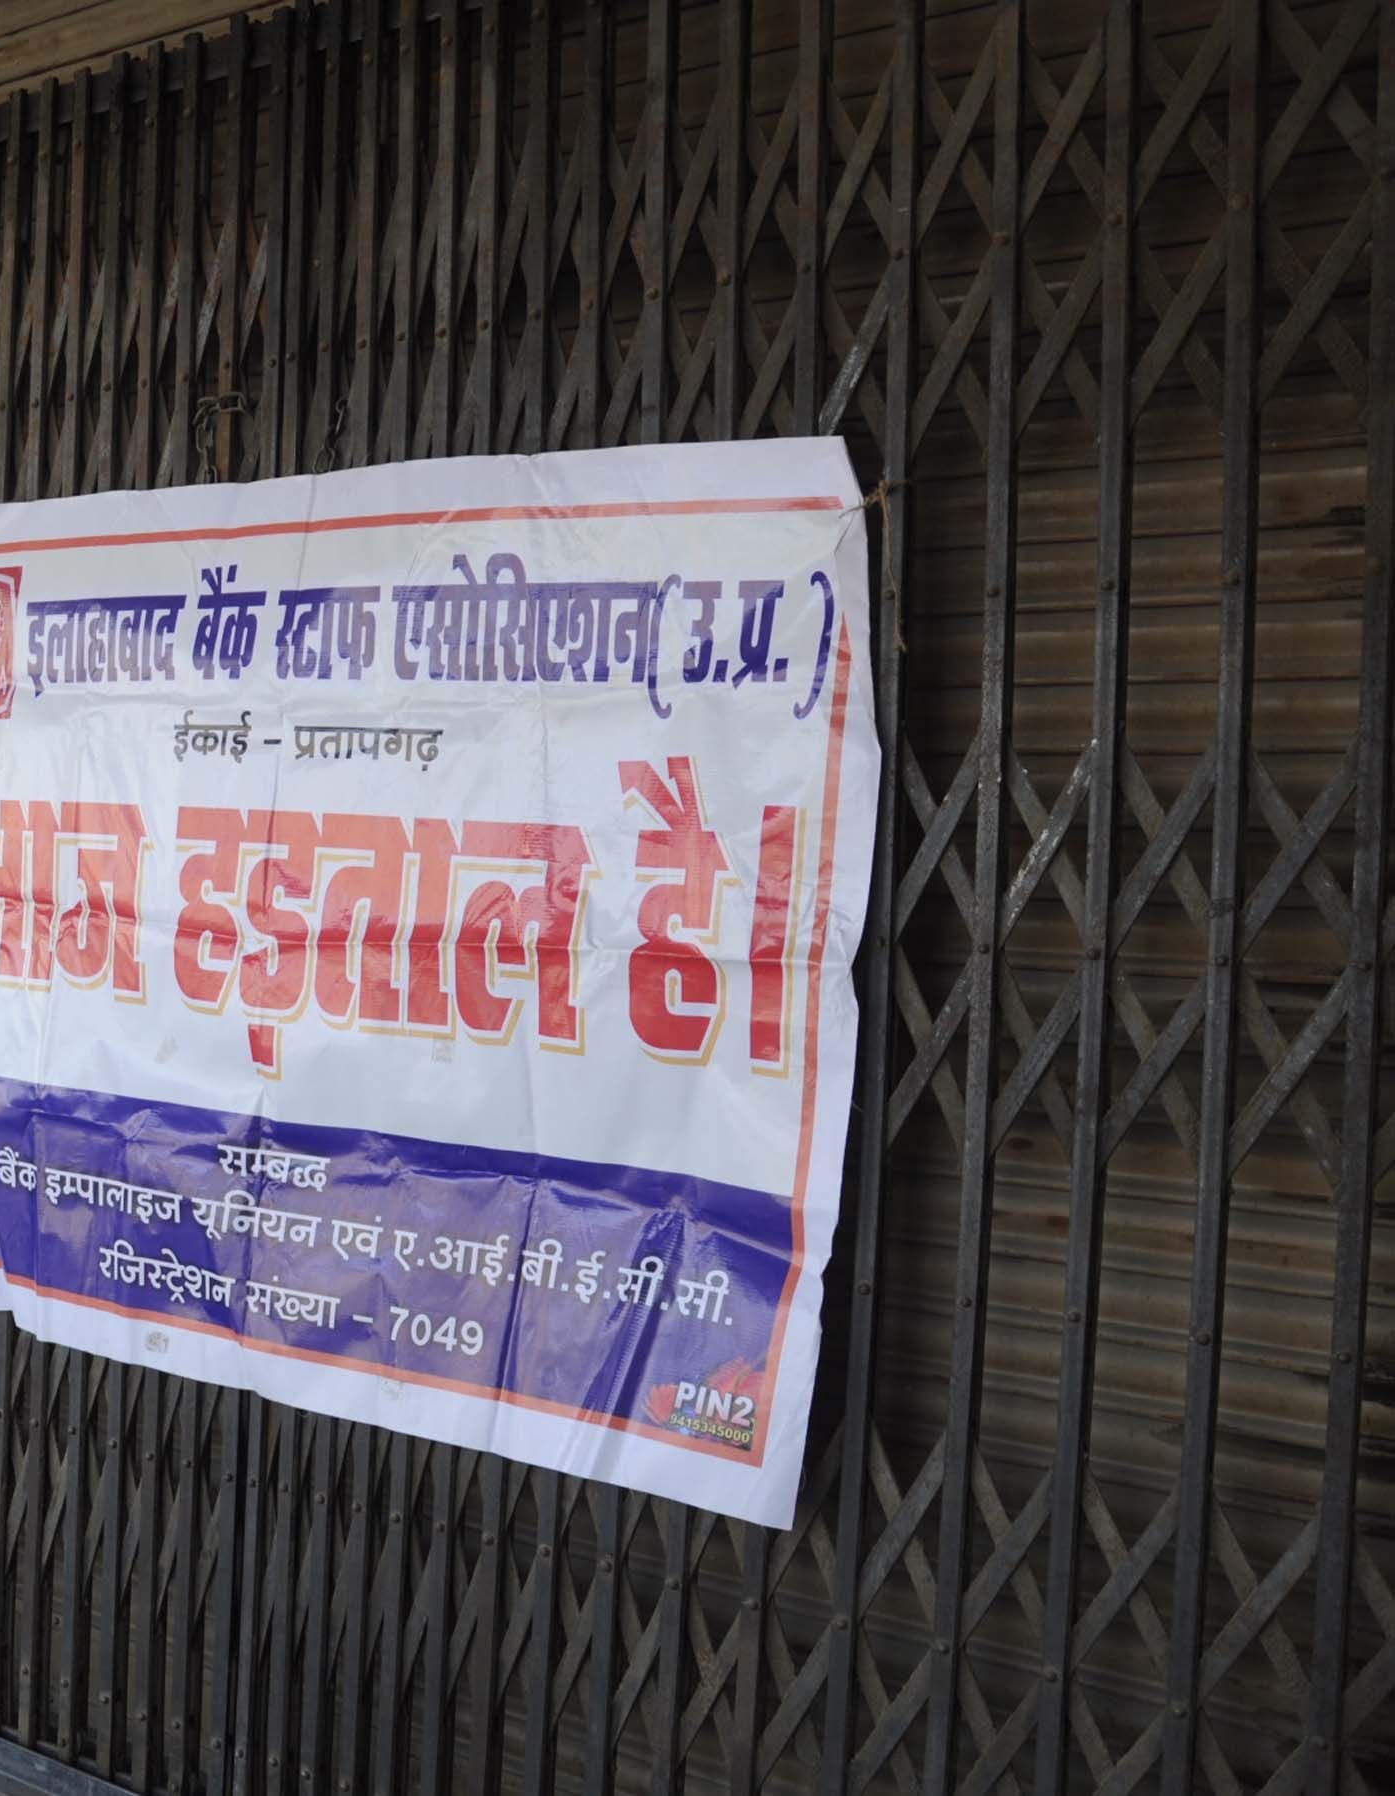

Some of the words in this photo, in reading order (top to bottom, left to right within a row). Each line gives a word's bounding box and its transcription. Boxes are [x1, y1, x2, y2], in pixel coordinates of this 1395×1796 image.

[26, 594, 187, 698] इलाहाबाद
[192, 564, 267, 681] बैंक
[274, 585, 382, 681] स्टाफ
[173, 710, 252, 763] ईकाई
[294, 724, 444, 771] प्रतापगढ़
[172, 805, 603, 1080] हड़ताल
[45, 1166, 183, 1225] इम्पालाइज
[192, 1190, 321, 1248] यूनियन
[331, 1216, 384, 1260] एवं
[217, 1144, 331, 1192] सम्बद्ध
[99, 1240, 235, 1308] रजिस्ट्रेशन
[245, 1277, 340, 1330] संख्या
[389, 1305, 486, 1357] 7049
[674, 1381, 754, 1428] PIN2
